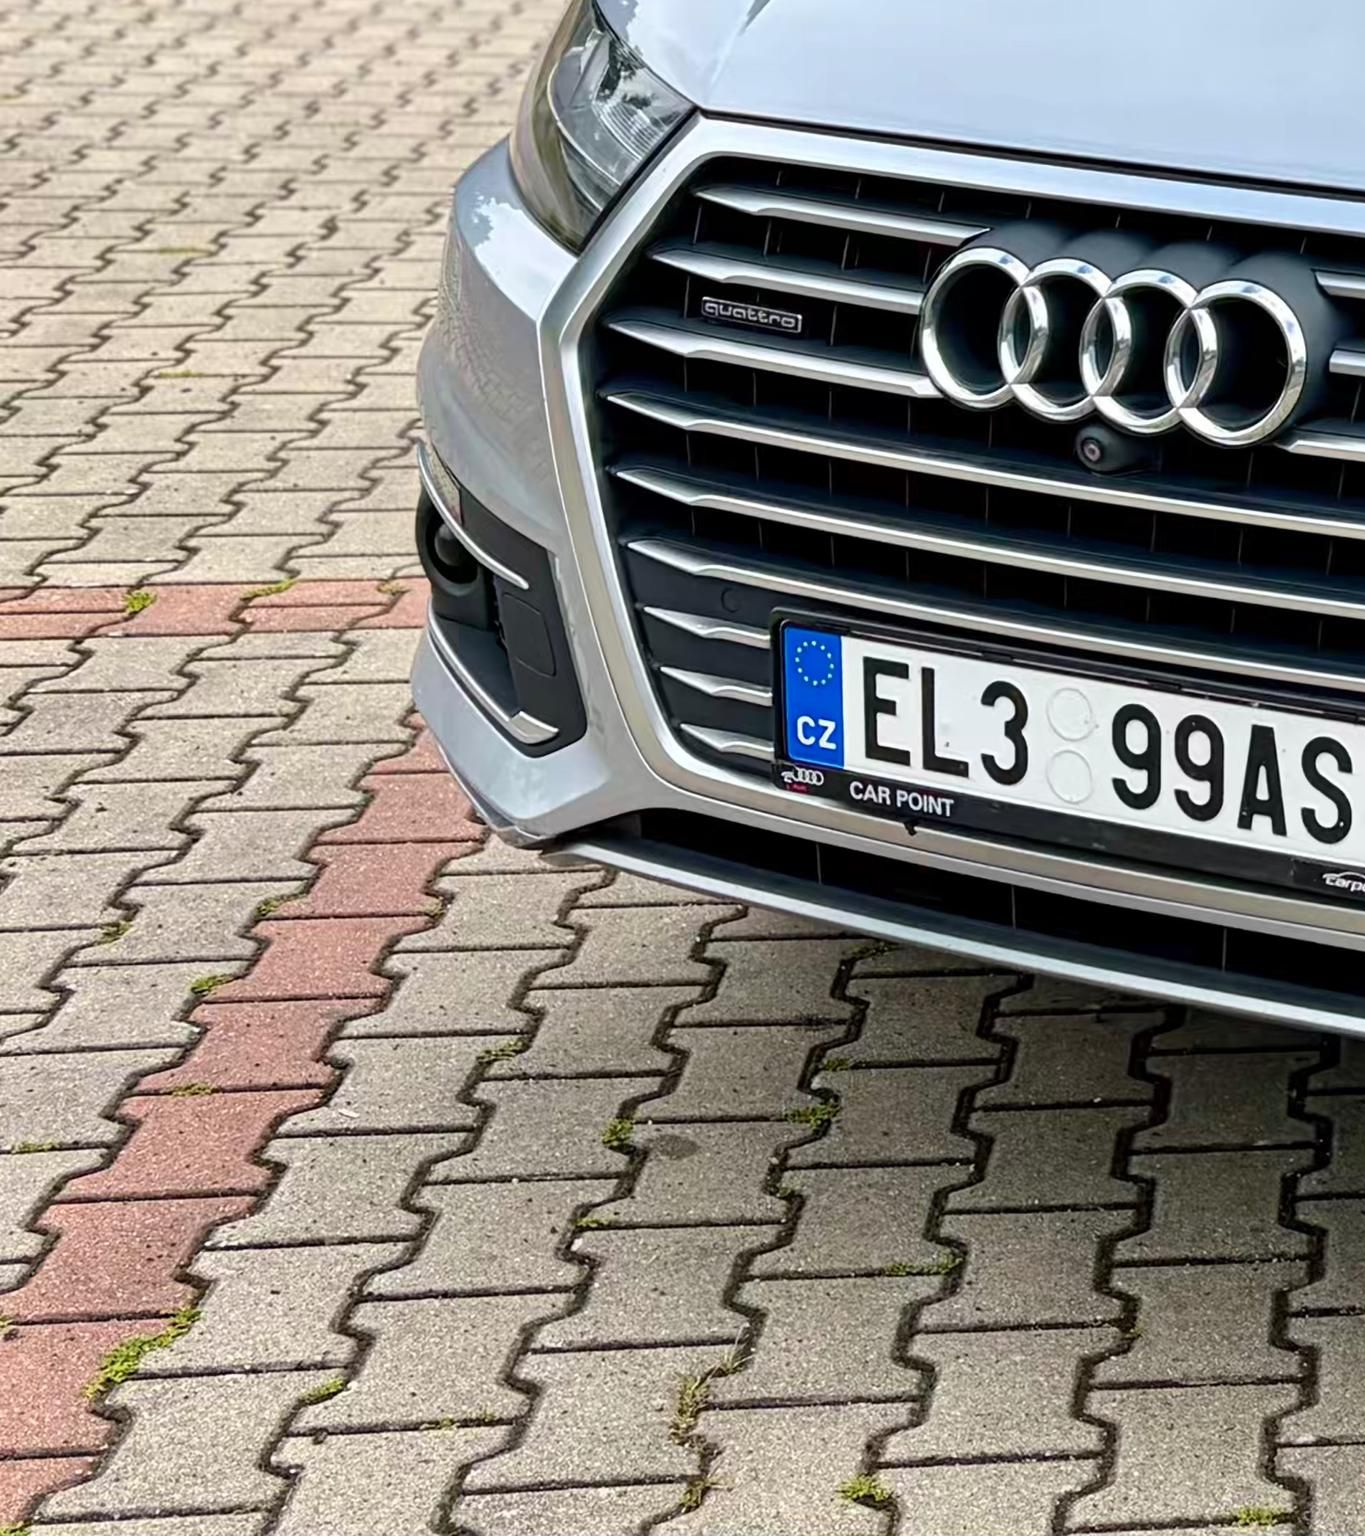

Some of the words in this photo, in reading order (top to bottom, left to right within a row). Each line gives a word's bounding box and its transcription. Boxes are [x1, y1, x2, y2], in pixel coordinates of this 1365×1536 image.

[704, 302, 796, 328] quattro
[797, 715, 837, 750] CZ
[862, 655, 1029, 786] EL3
[1111, 702, 1353, 845] 99AS
[849, 781, 891, 806] CAR
[896, 790, 954, 817] POINT
